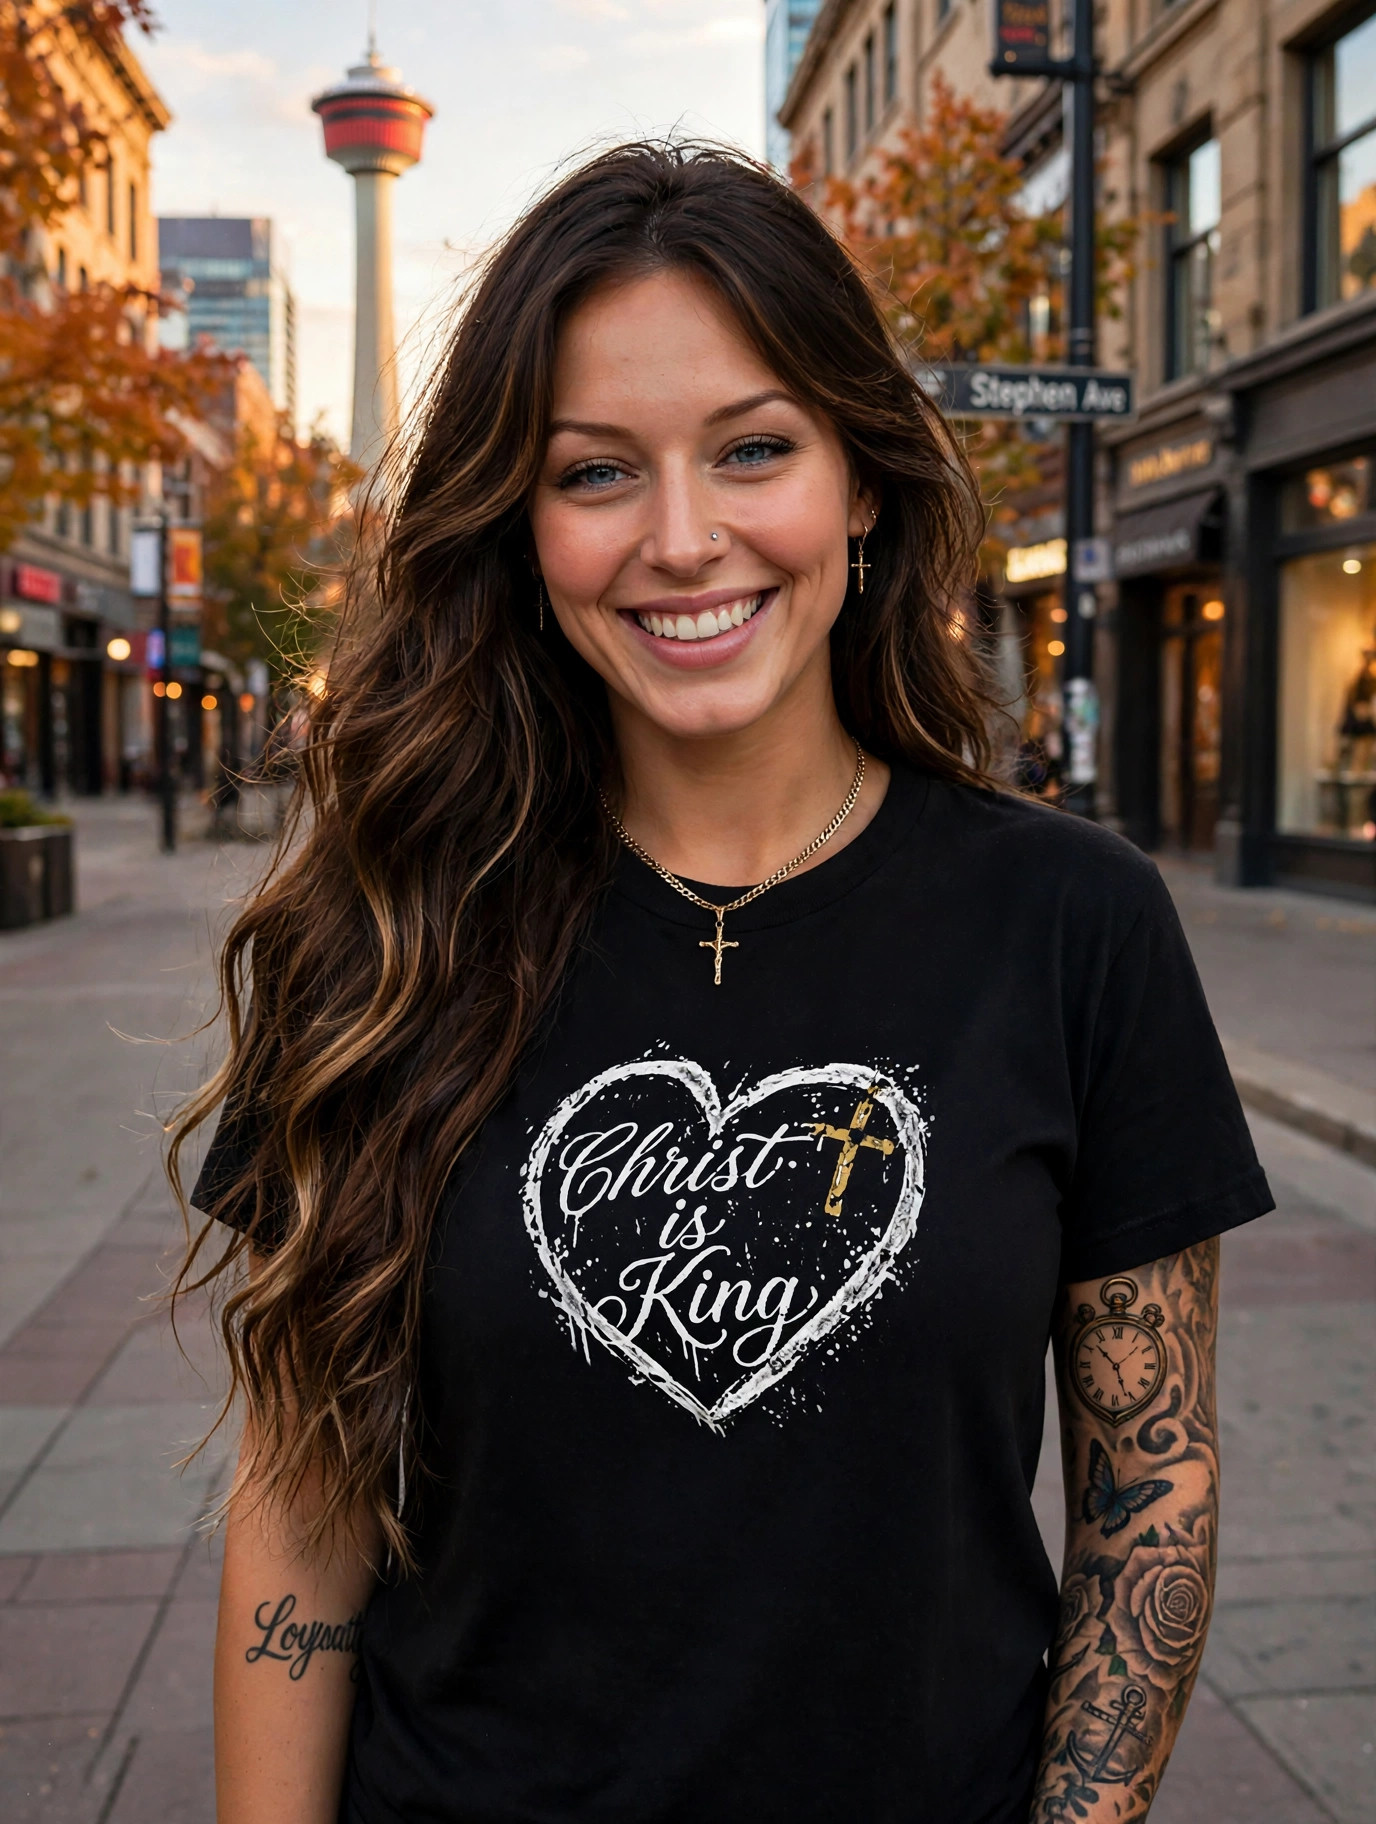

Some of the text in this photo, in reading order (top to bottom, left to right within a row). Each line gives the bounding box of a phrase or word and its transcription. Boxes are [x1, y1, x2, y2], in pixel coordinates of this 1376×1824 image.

[969, 371, 1077, 416] Stephen
[1082, 378, 1127, 413] Ave
[559, 1121, 815, 1217] Christ
[658, 1198, 726, 1249] is
[596, 1245, 819, 1367] King
